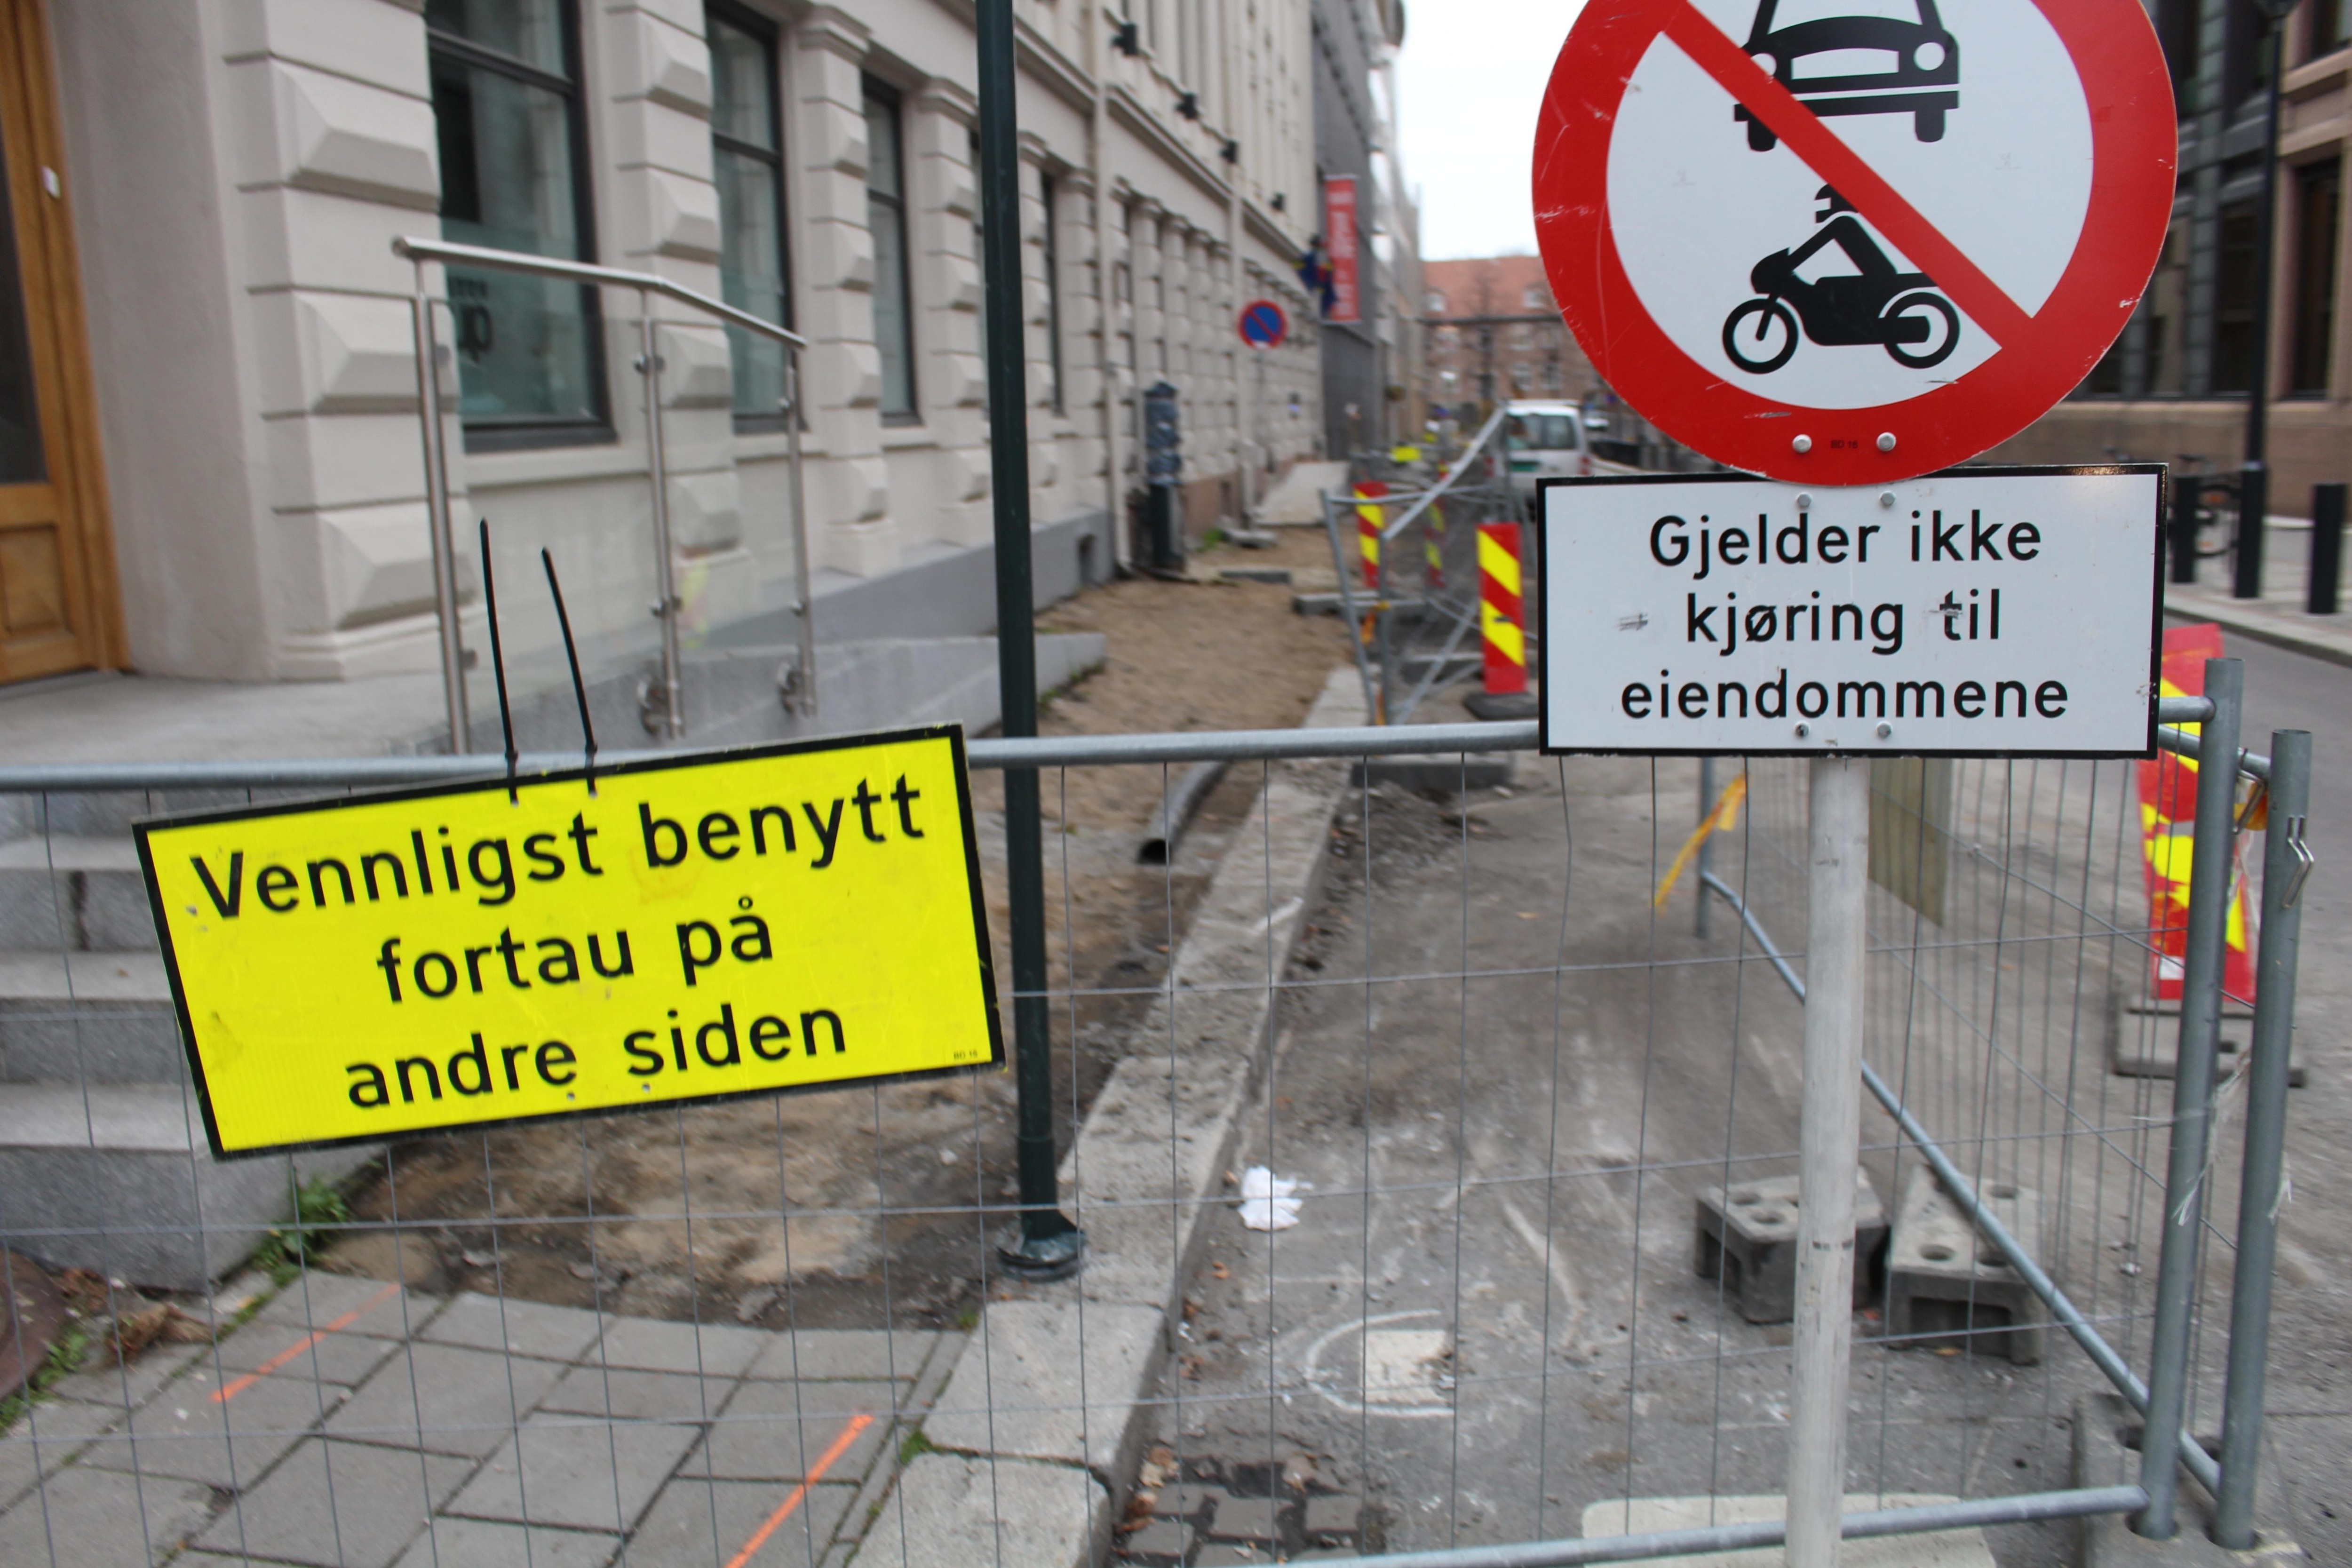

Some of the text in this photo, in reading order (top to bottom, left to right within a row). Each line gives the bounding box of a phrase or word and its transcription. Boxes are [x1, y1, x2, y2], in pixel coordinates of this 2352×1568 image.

[1650, 509, 2041, 580] Gjelder ikke
[1687, 589, 2000, 655] kjøring til
[1621, 669, 2068, 719] eiendommene
[190, 774, 924, 918] Vennligst benytt
[376, 897, 772, 1003] fortau på
[346, 1003, 845, 1108] andre siden
